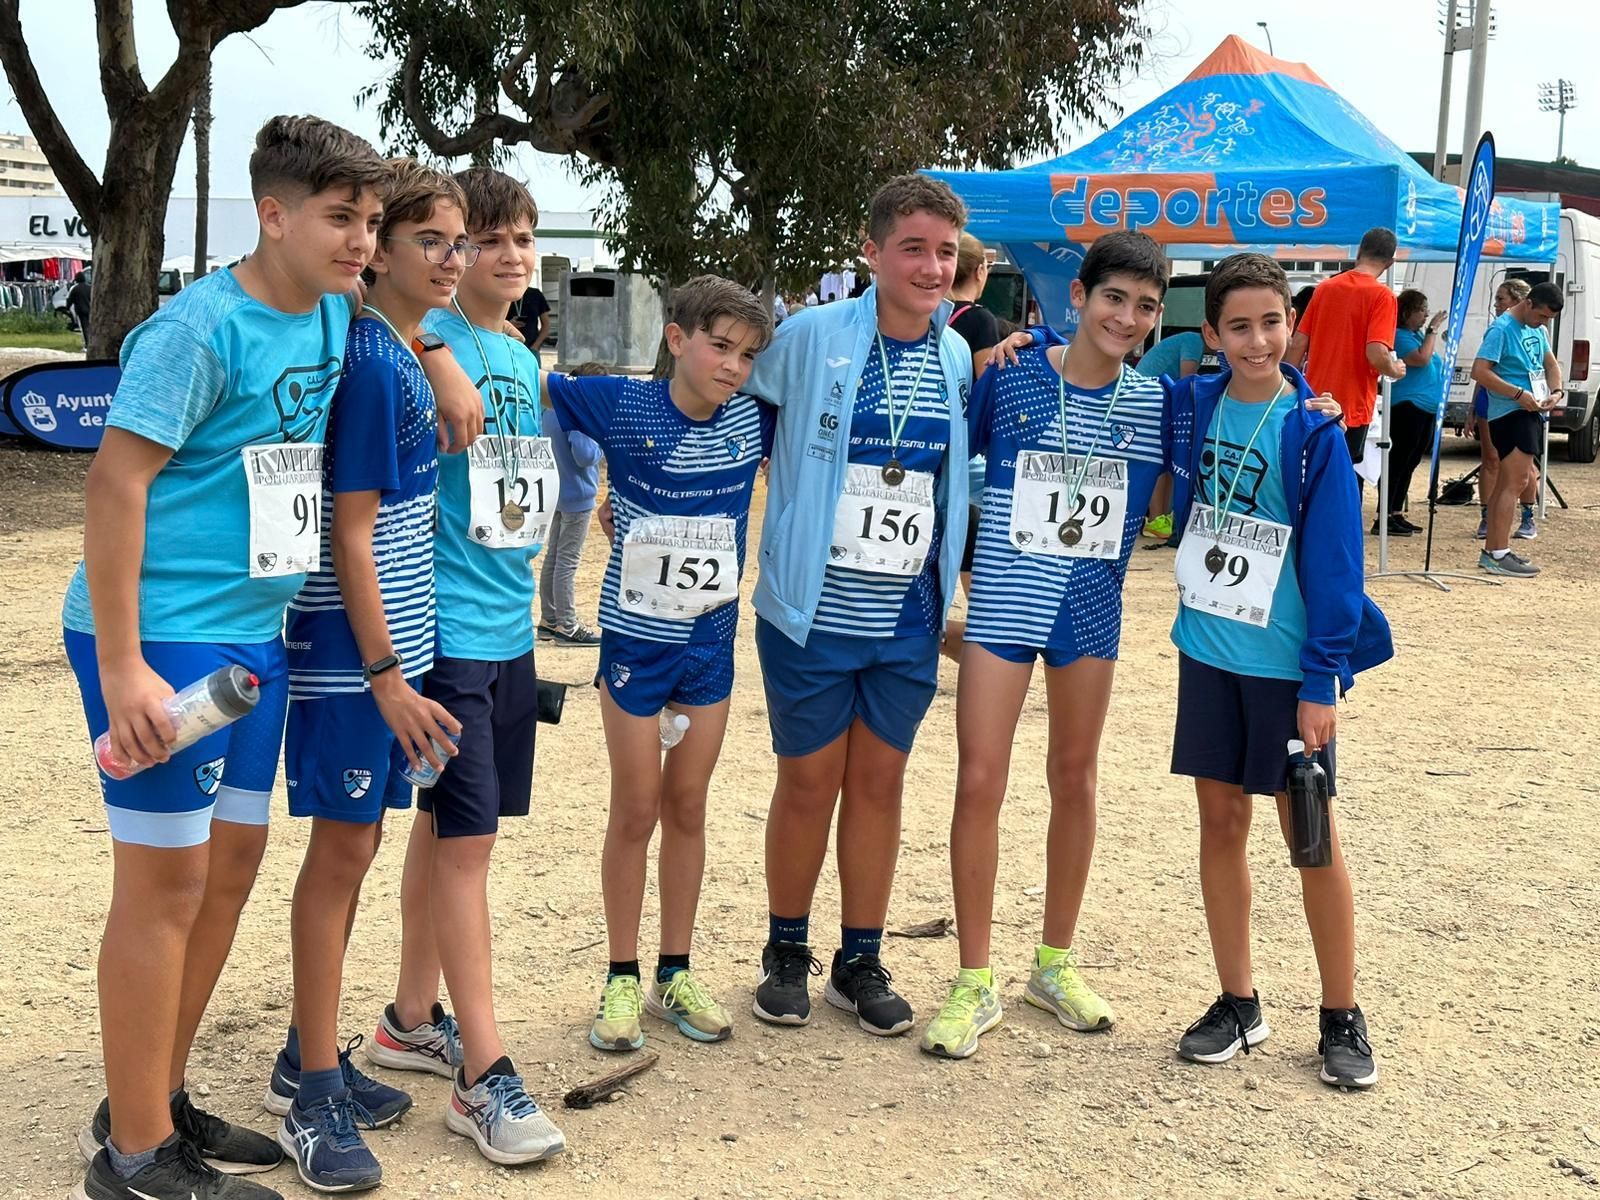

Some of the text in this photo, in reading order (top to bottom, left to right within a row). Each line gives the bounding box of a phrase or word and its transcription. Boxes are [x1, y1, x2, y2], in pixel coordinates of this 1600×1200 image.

[1050, 175, 1328, 231] deportes
[29, 215, 58, 236] EL
[79, 412, 103, 427] de
[493, 477, 545, 514] 121
[628, 475, 650, 491] CLUB
[653, 487, 713, 499] ATLETISMO
[293, 493, 320, 537] 91
[856, 505, 921, 546] 156
[1043, 490, 1110, 528] 129
[653, 554, 721, 591] 152
